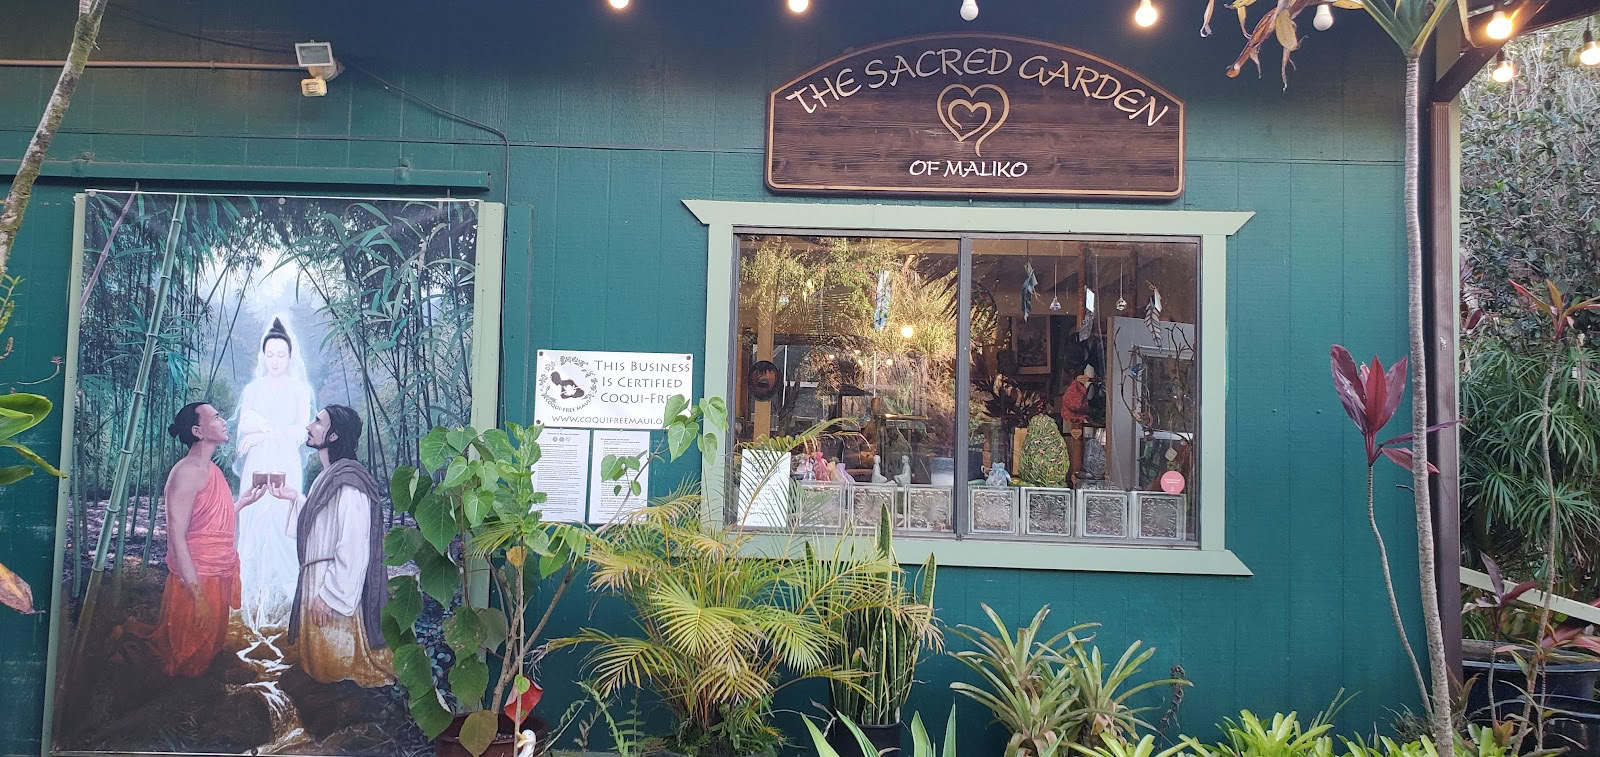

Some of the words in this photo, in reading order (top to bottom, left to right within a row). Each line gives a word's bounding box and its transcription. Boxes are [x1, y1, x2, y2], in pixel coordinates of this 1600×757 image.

[786, 67, 862, 114] THE
[864, 47, 1013, 89] SACRED
[1018, 55, 1169, 127] GARDEN
[909, 160, 940, 176] OF
[943, 160, 1028, 178] MALIKO
[594, 360, 625, 372] THIS
[631, 361, 690, 373] BUSINESS
[602, 376, 613, 387] IS
[617, 377, 683, 388] CERTIFIED
